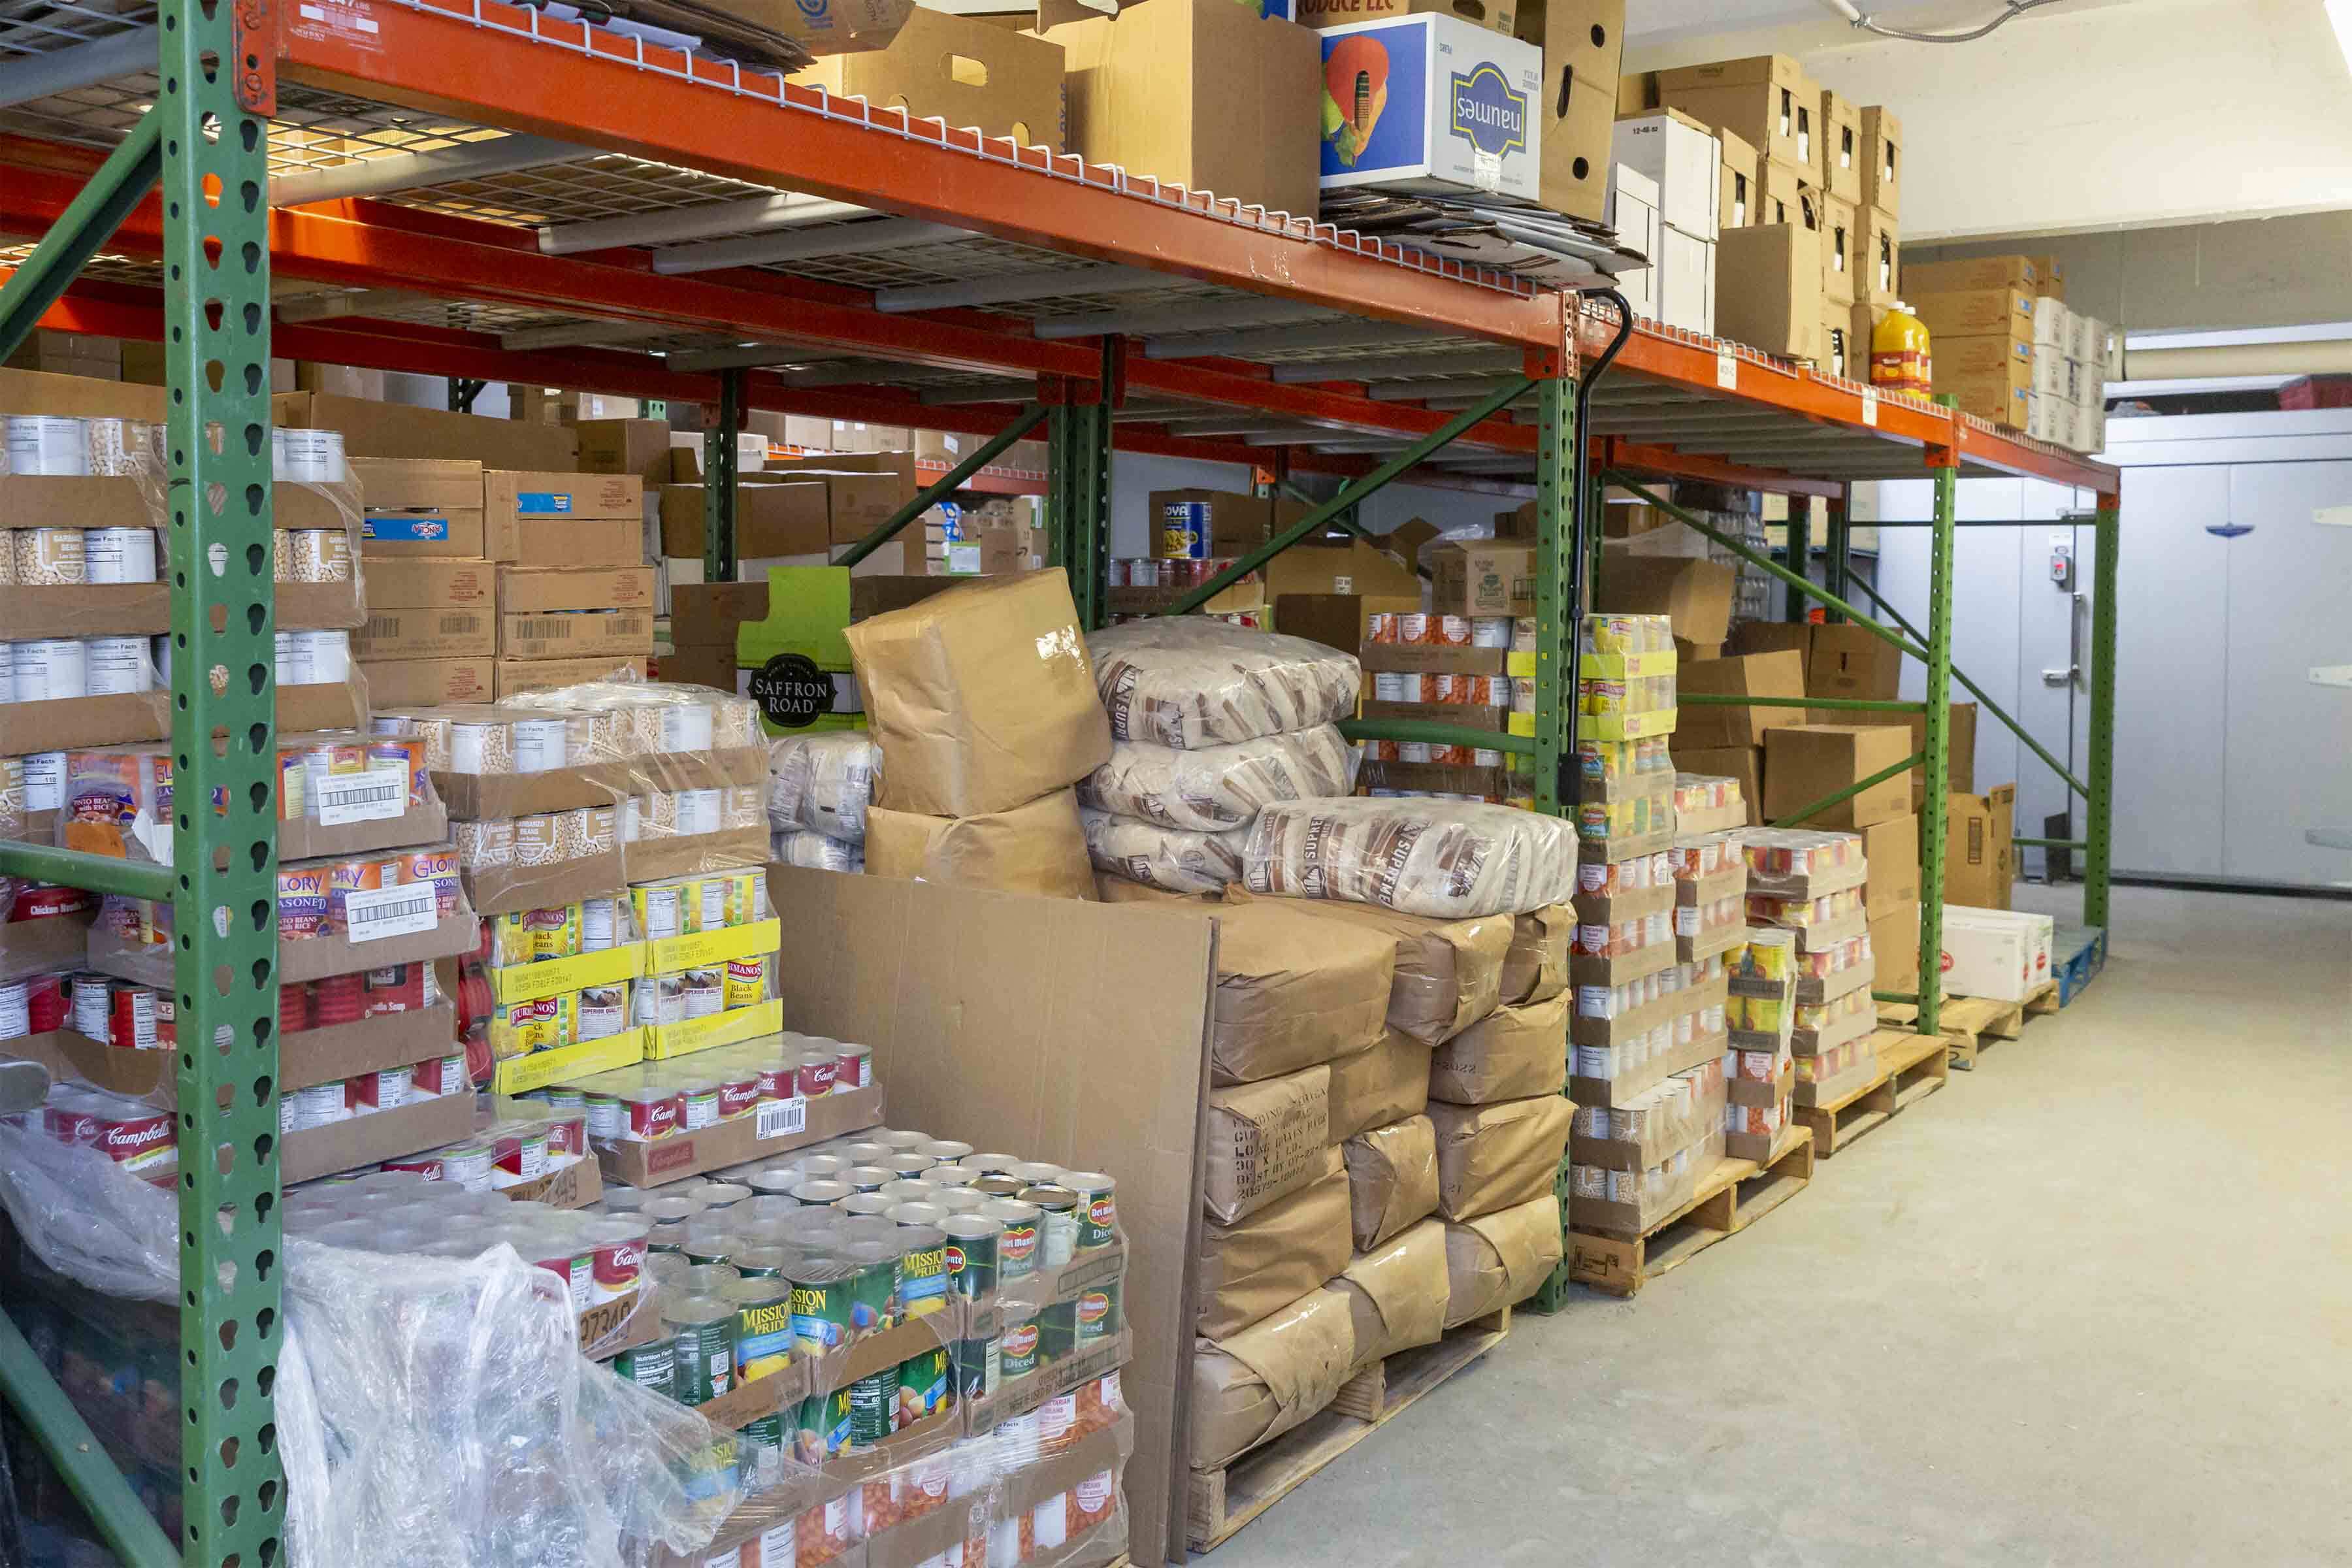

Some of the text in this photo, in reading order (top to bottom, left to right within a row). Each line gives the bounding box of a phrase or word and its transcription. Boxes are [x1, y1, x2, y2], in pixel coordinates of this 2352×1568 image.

[1456, 97, 1522, 133] naumes
[1162, 505, 1189, 516] OYA
[755, 678, 827, 698] SAFFRON
[768, 696, 814, 713] ROAD
[412, 855, 457, 879] GLOR
[1379, 839, 1412, 906] SUPREME
[279, 872, 324, 898] LORY
[903, 1248, 946, 1273] MISSIO
[790, 1289, 826, 1311] SSION
[791, 1307, 816, 1316] RIDE
[1004, 1353, 1035, 1369] Diced
